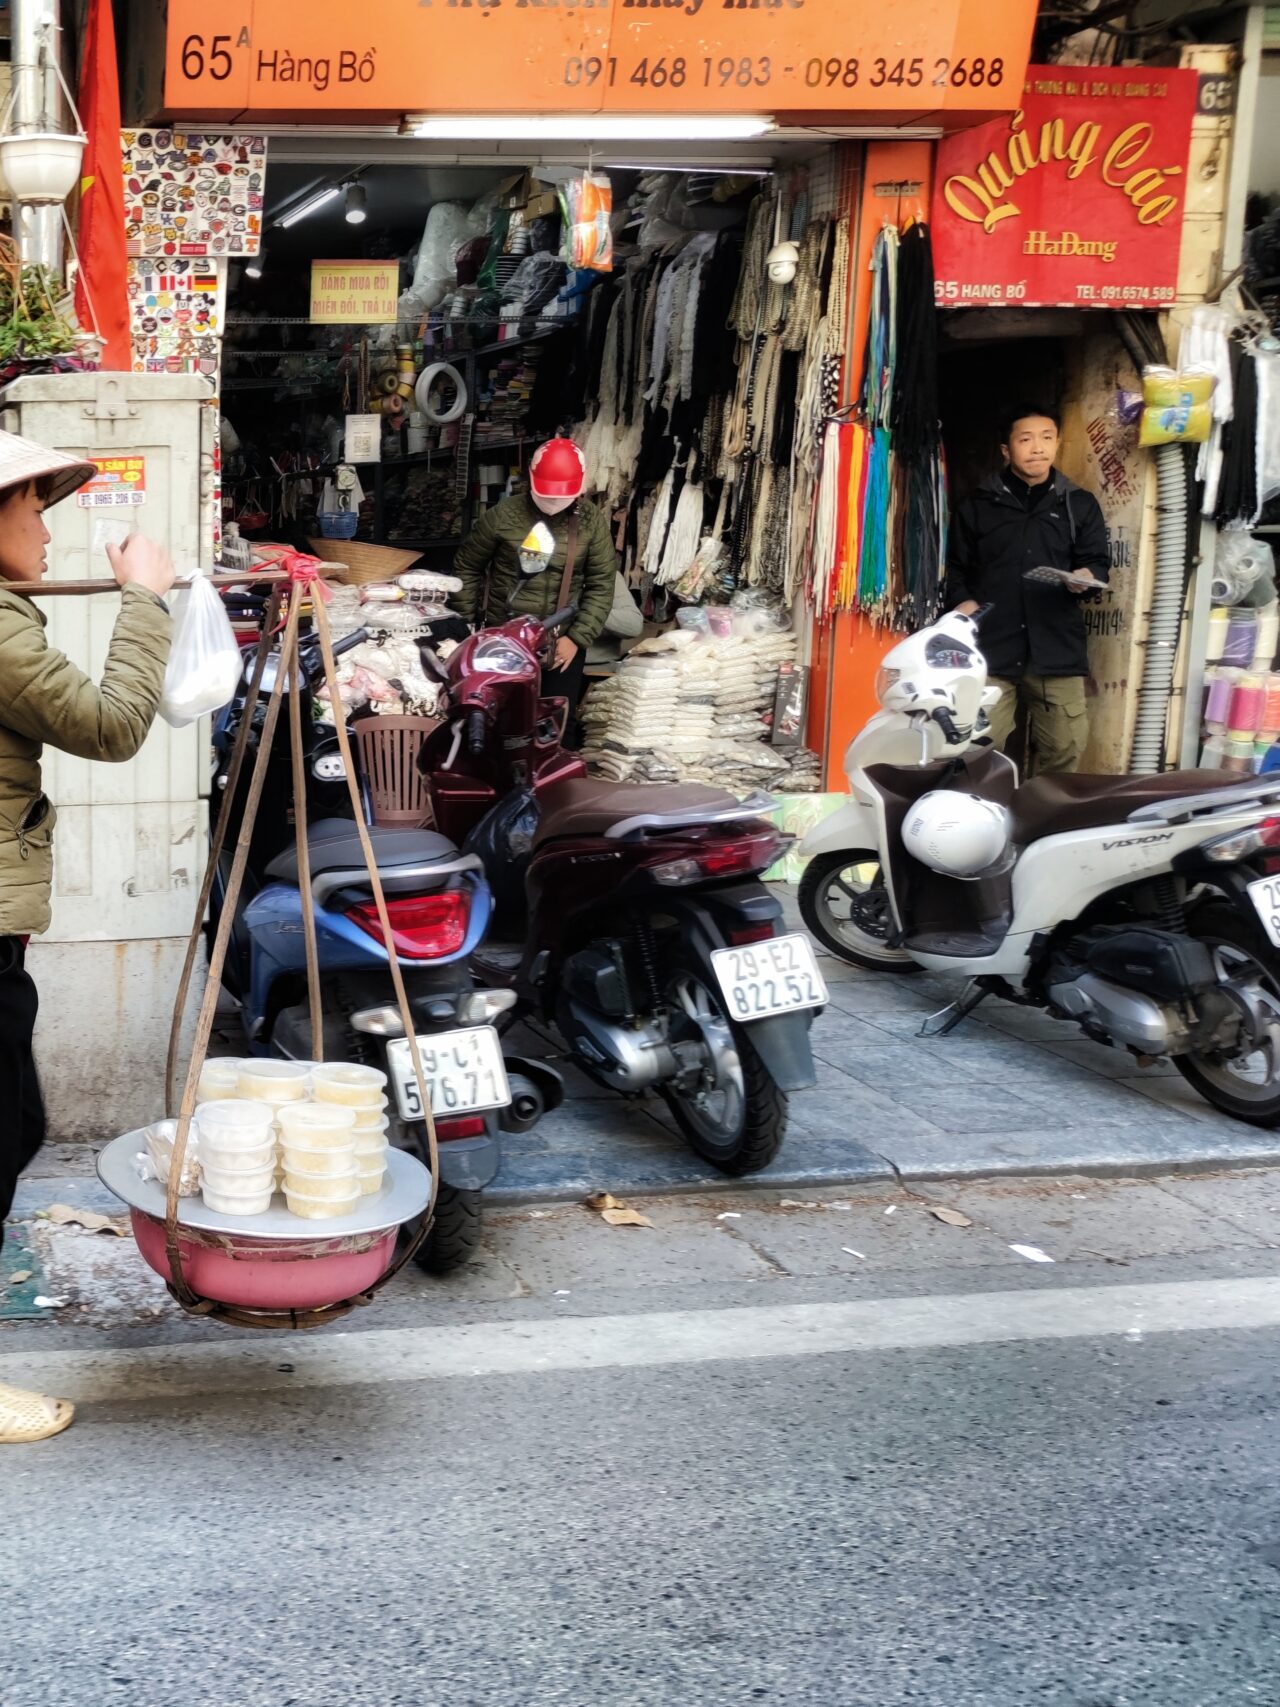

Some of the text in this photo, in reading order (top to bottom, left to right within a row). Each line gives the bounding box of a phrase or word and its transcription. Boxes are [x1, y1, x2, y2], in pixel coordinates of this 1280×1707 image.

[256, 49, 330, 91] Hàng
[338, 47, 377, 83] Bồ
[565, 56, 617, 88] 091
[630, 56, 687, 88] 468
[704, 56, 771, 88] 1983
[805, 57, 860, 88] 098
[869, 57, 924, 88] 345
[932, 57, 1004, 88] 2688
[1102, 122, 1183, 227] Cáo
[349, 276, 371, 290] MUA
[1102, 832, 1175, 851] VISION
[728, 941, 800, 981] 29-E2
[732, 972, 820, 1014] 822.52
[403, 1069, 500, 1114] 576.71
